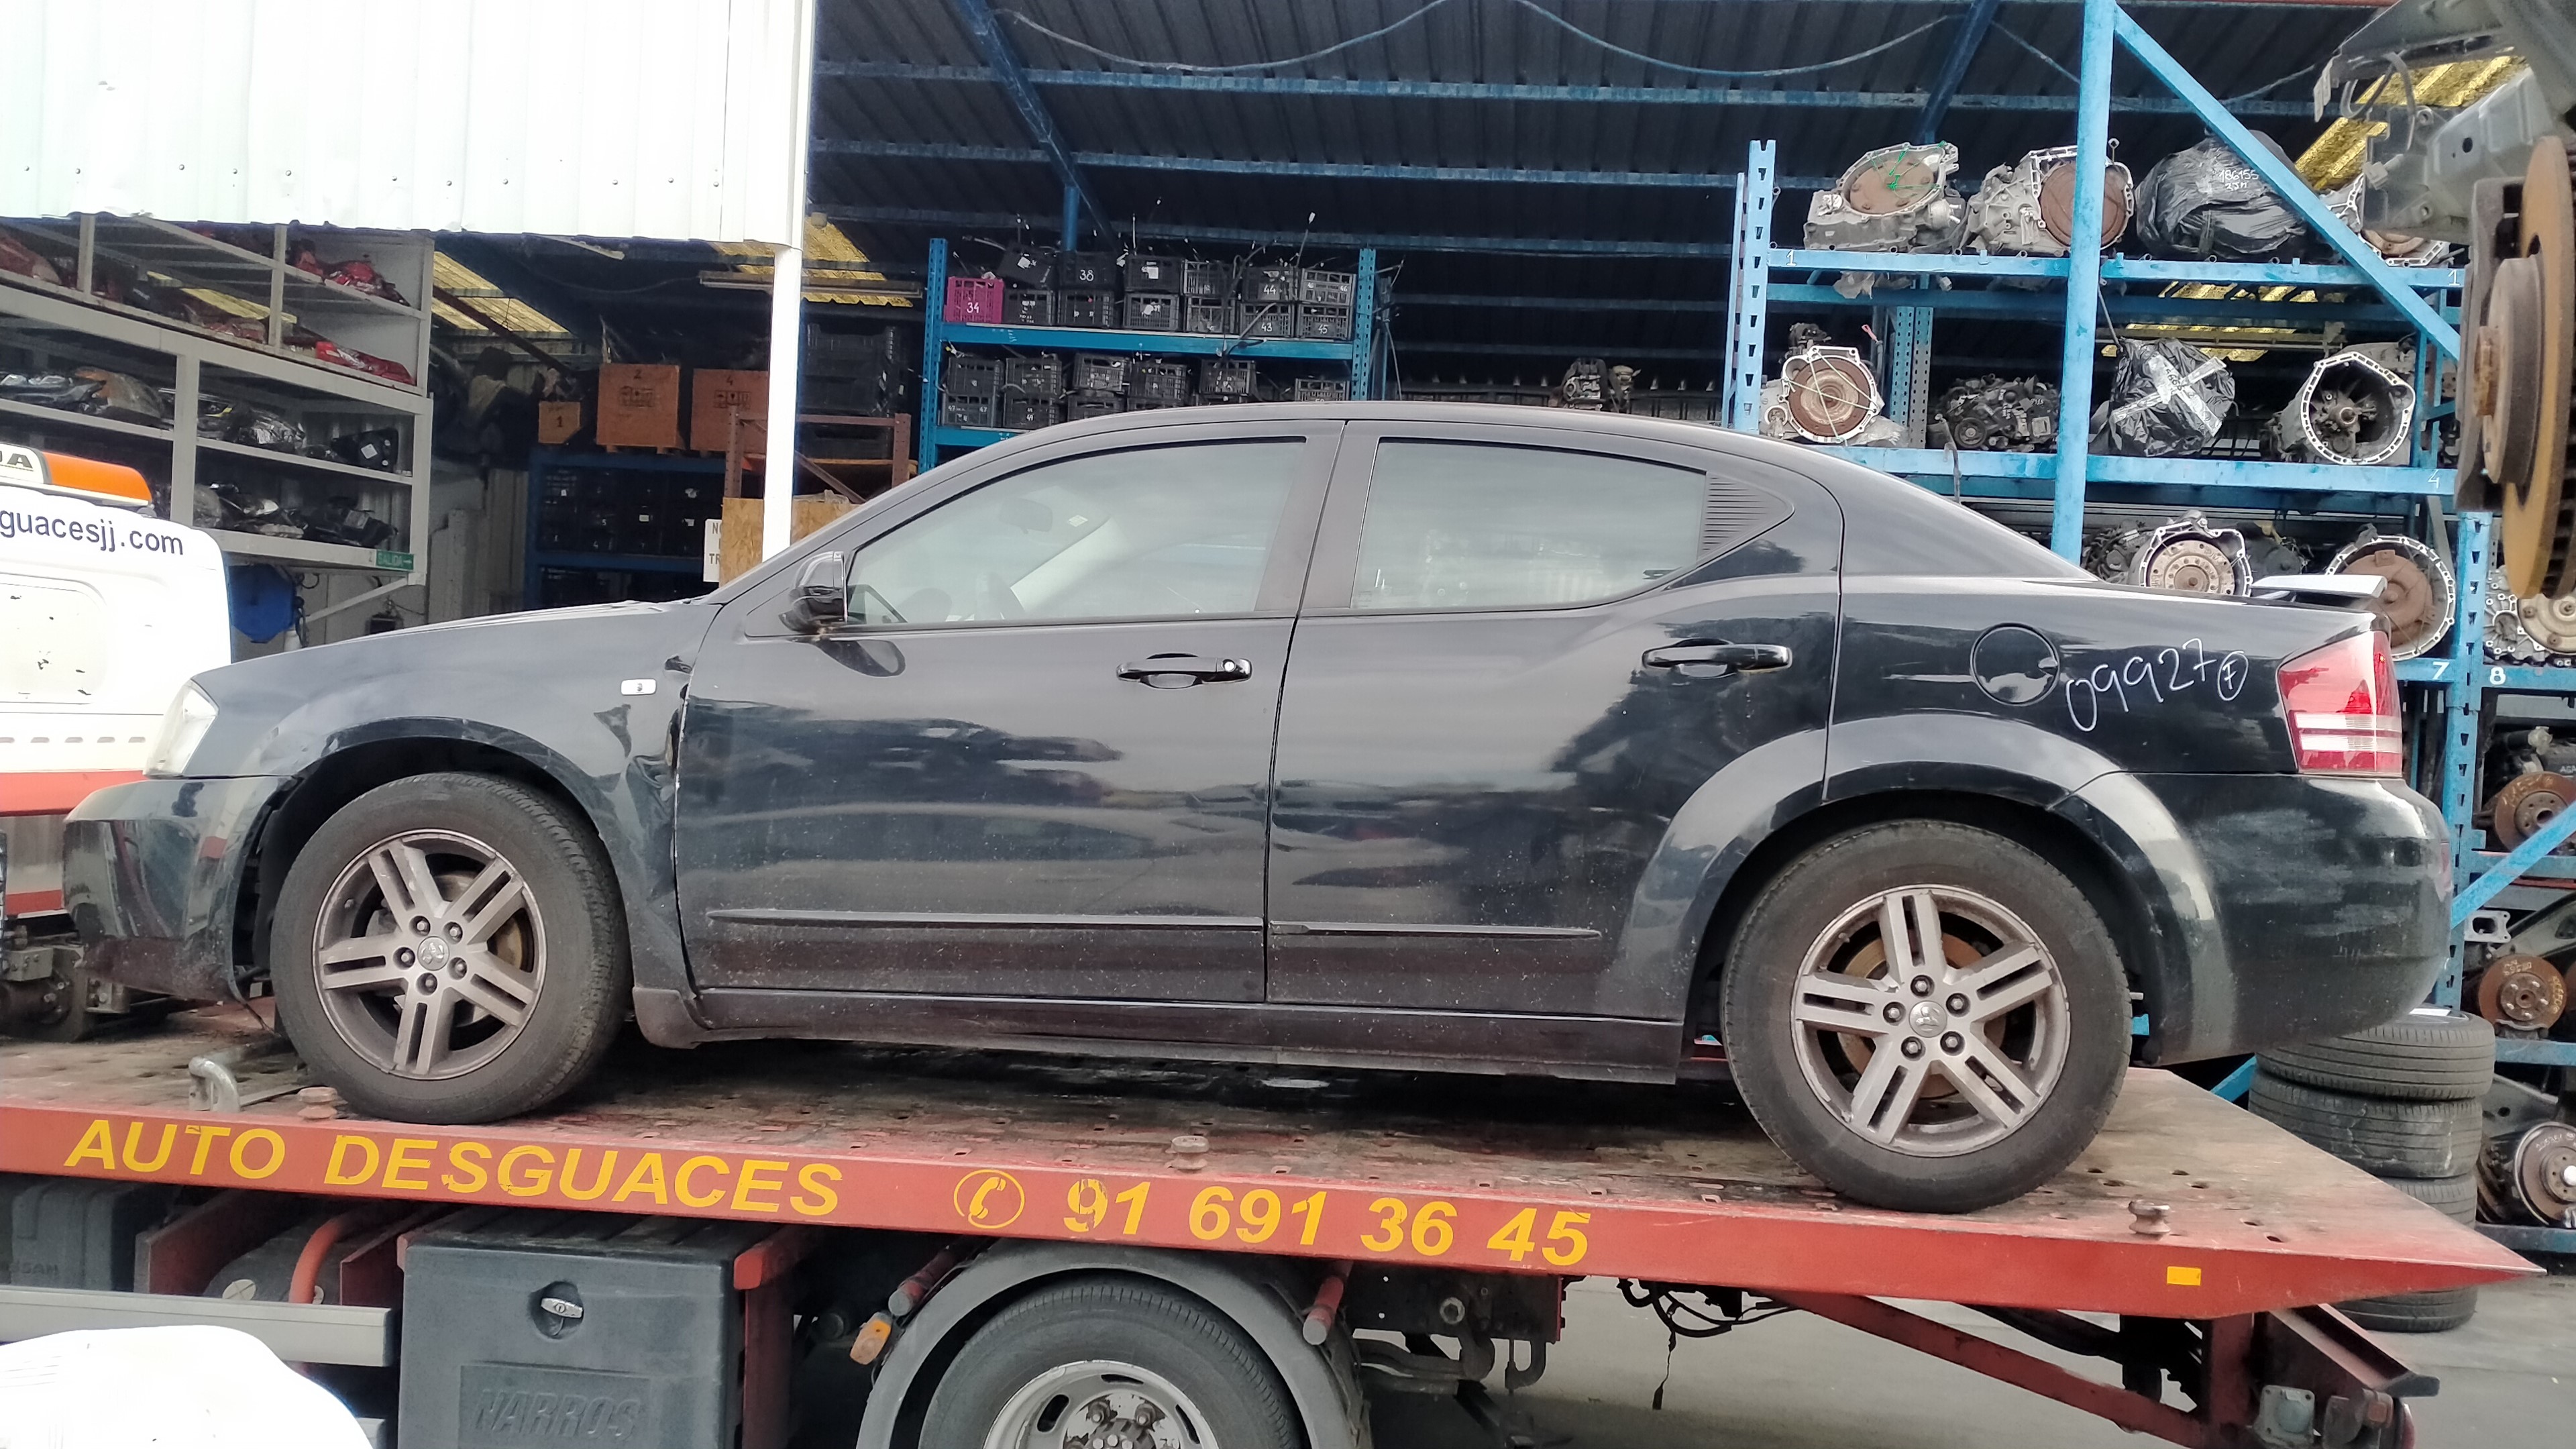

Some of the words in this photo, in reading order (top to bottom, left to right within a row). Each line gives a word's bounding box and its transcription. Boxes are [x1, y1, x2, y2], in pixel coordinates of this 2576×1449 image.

[1786, 250, 1796, 267] 1
[1079, 269, 1094, 282] 38
[2448, 269, 2460, 286] 1
[1264, 284, 1276, 295] 44
[967, 302, 979, 313] 34
[1261, 323, 1273, 332] 43
[1318, 324, 1329, 334] 45
[727, 376, 733, 386] 4
[556, 416, 563, 428] 1
[2427, 469, 2440, 488] 4
[0, 510, 184, 555] guacesjj.com
[2432, 661, 2450, 680] 7
[2489, 667, 2506, 685] 8
[2065, 637, 2217, 732] 09927
[63, 1119, 286, 1179] AUTO
[323, 1134, 843, 1216] DESGUACES
[1063, 1178, 1151, 1235] 91
[1189, 1185, 1328, 1246] 691
[1360, 1197, 1458, 1256] 36
[1486, 1208, 1592, 1266] 45
